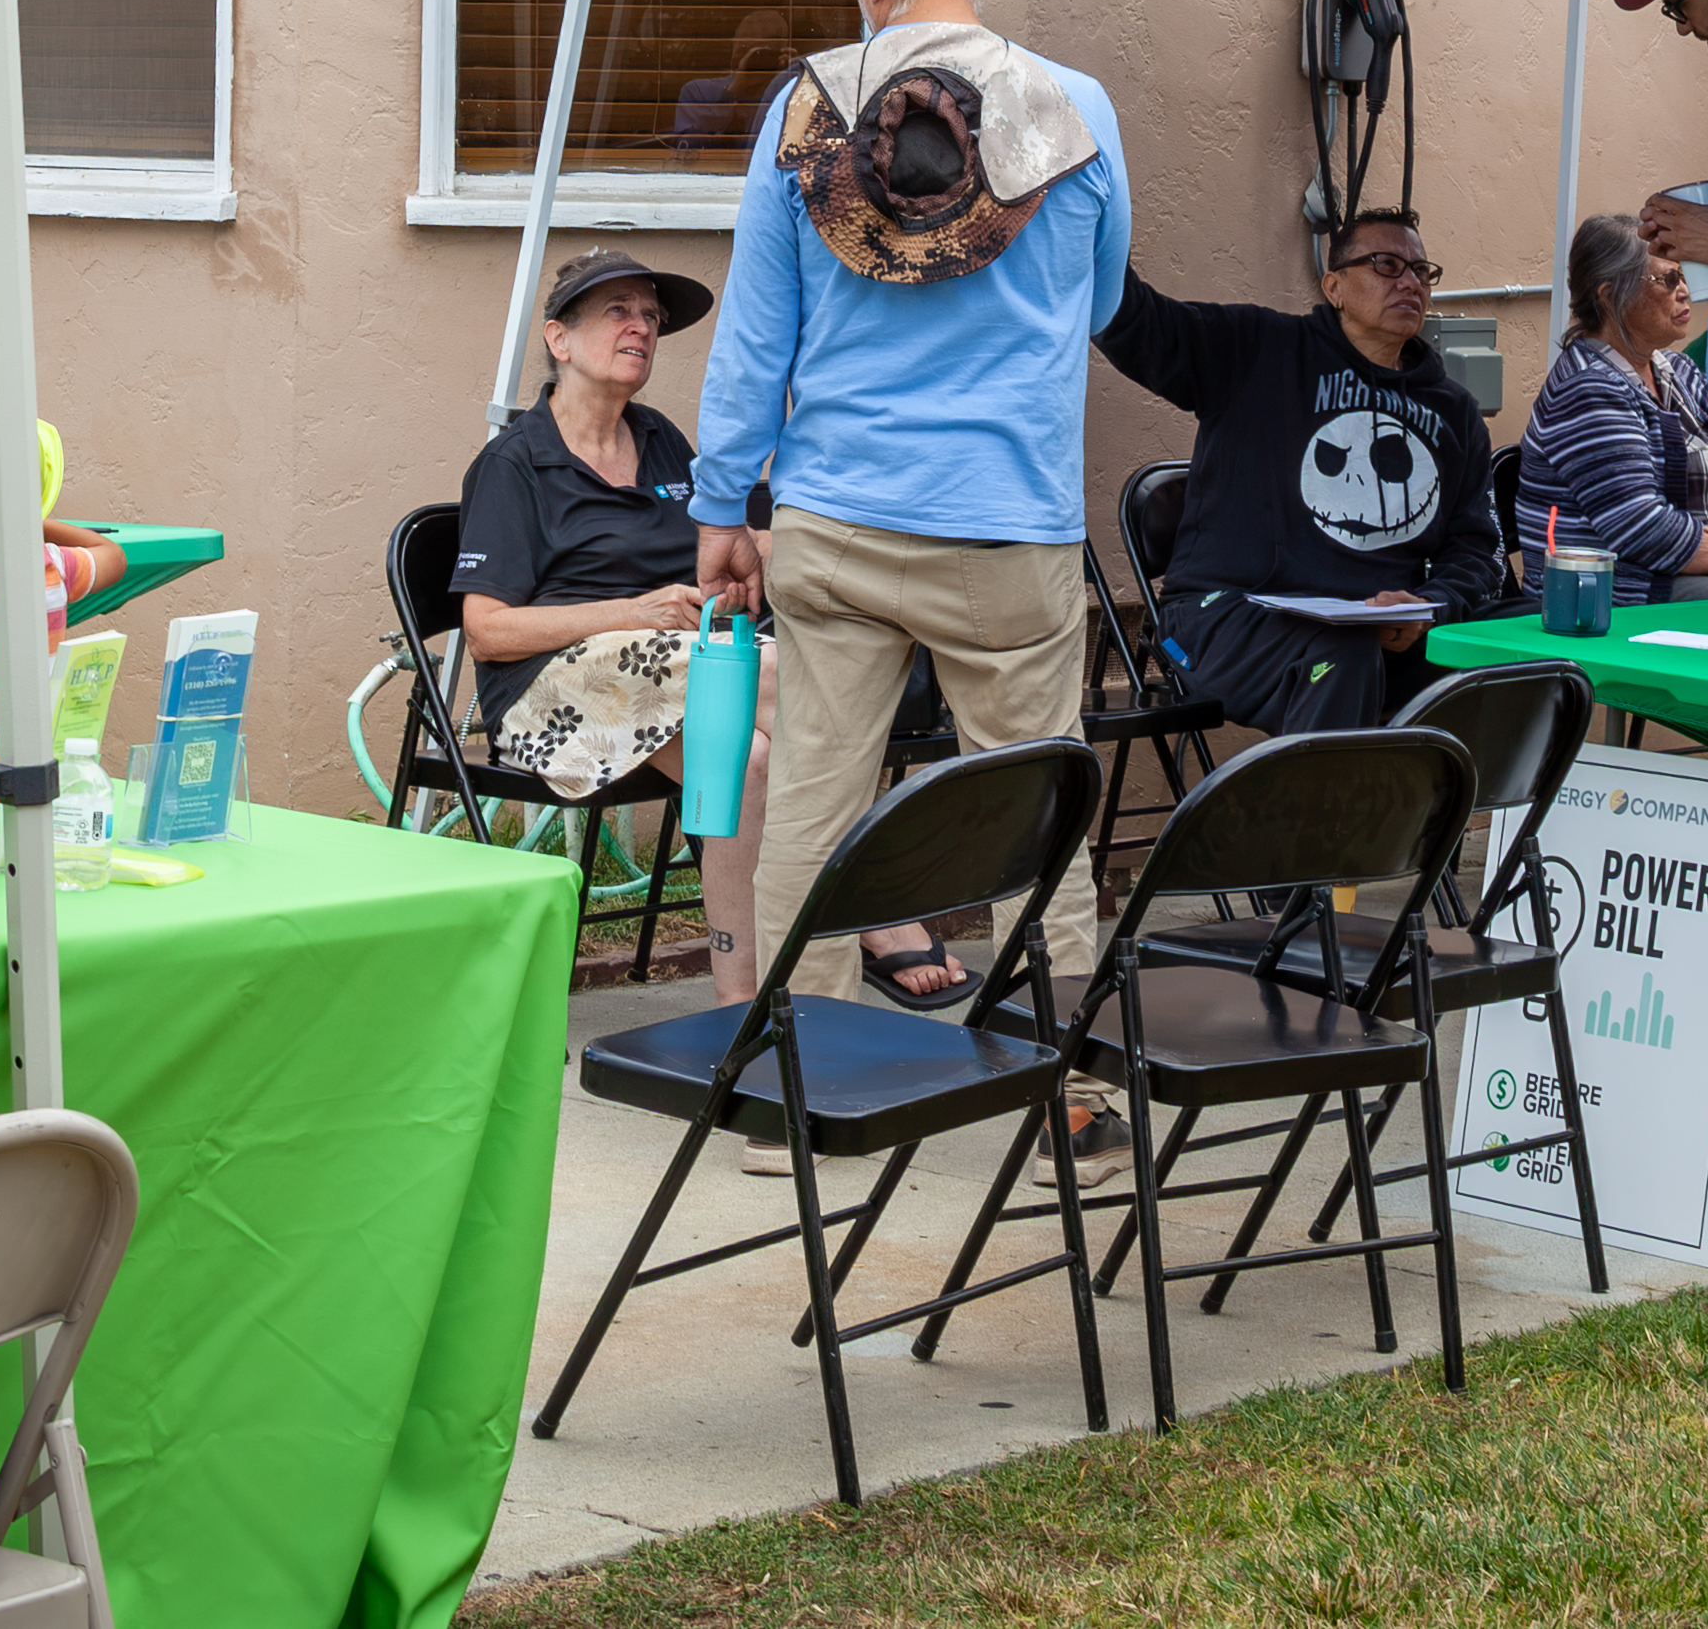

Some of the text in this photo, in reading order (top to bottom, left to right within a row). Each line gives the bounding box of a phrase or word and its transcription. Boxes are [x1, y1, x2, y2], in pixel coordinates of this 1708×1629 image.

[1554, 786, 1607, 811] ERGY
[1594, 900, 1664, 960] BILL
[1525, 1072, 1603, 1107] BEFRE
[1516, 1158, 1564, 1185] GRID
